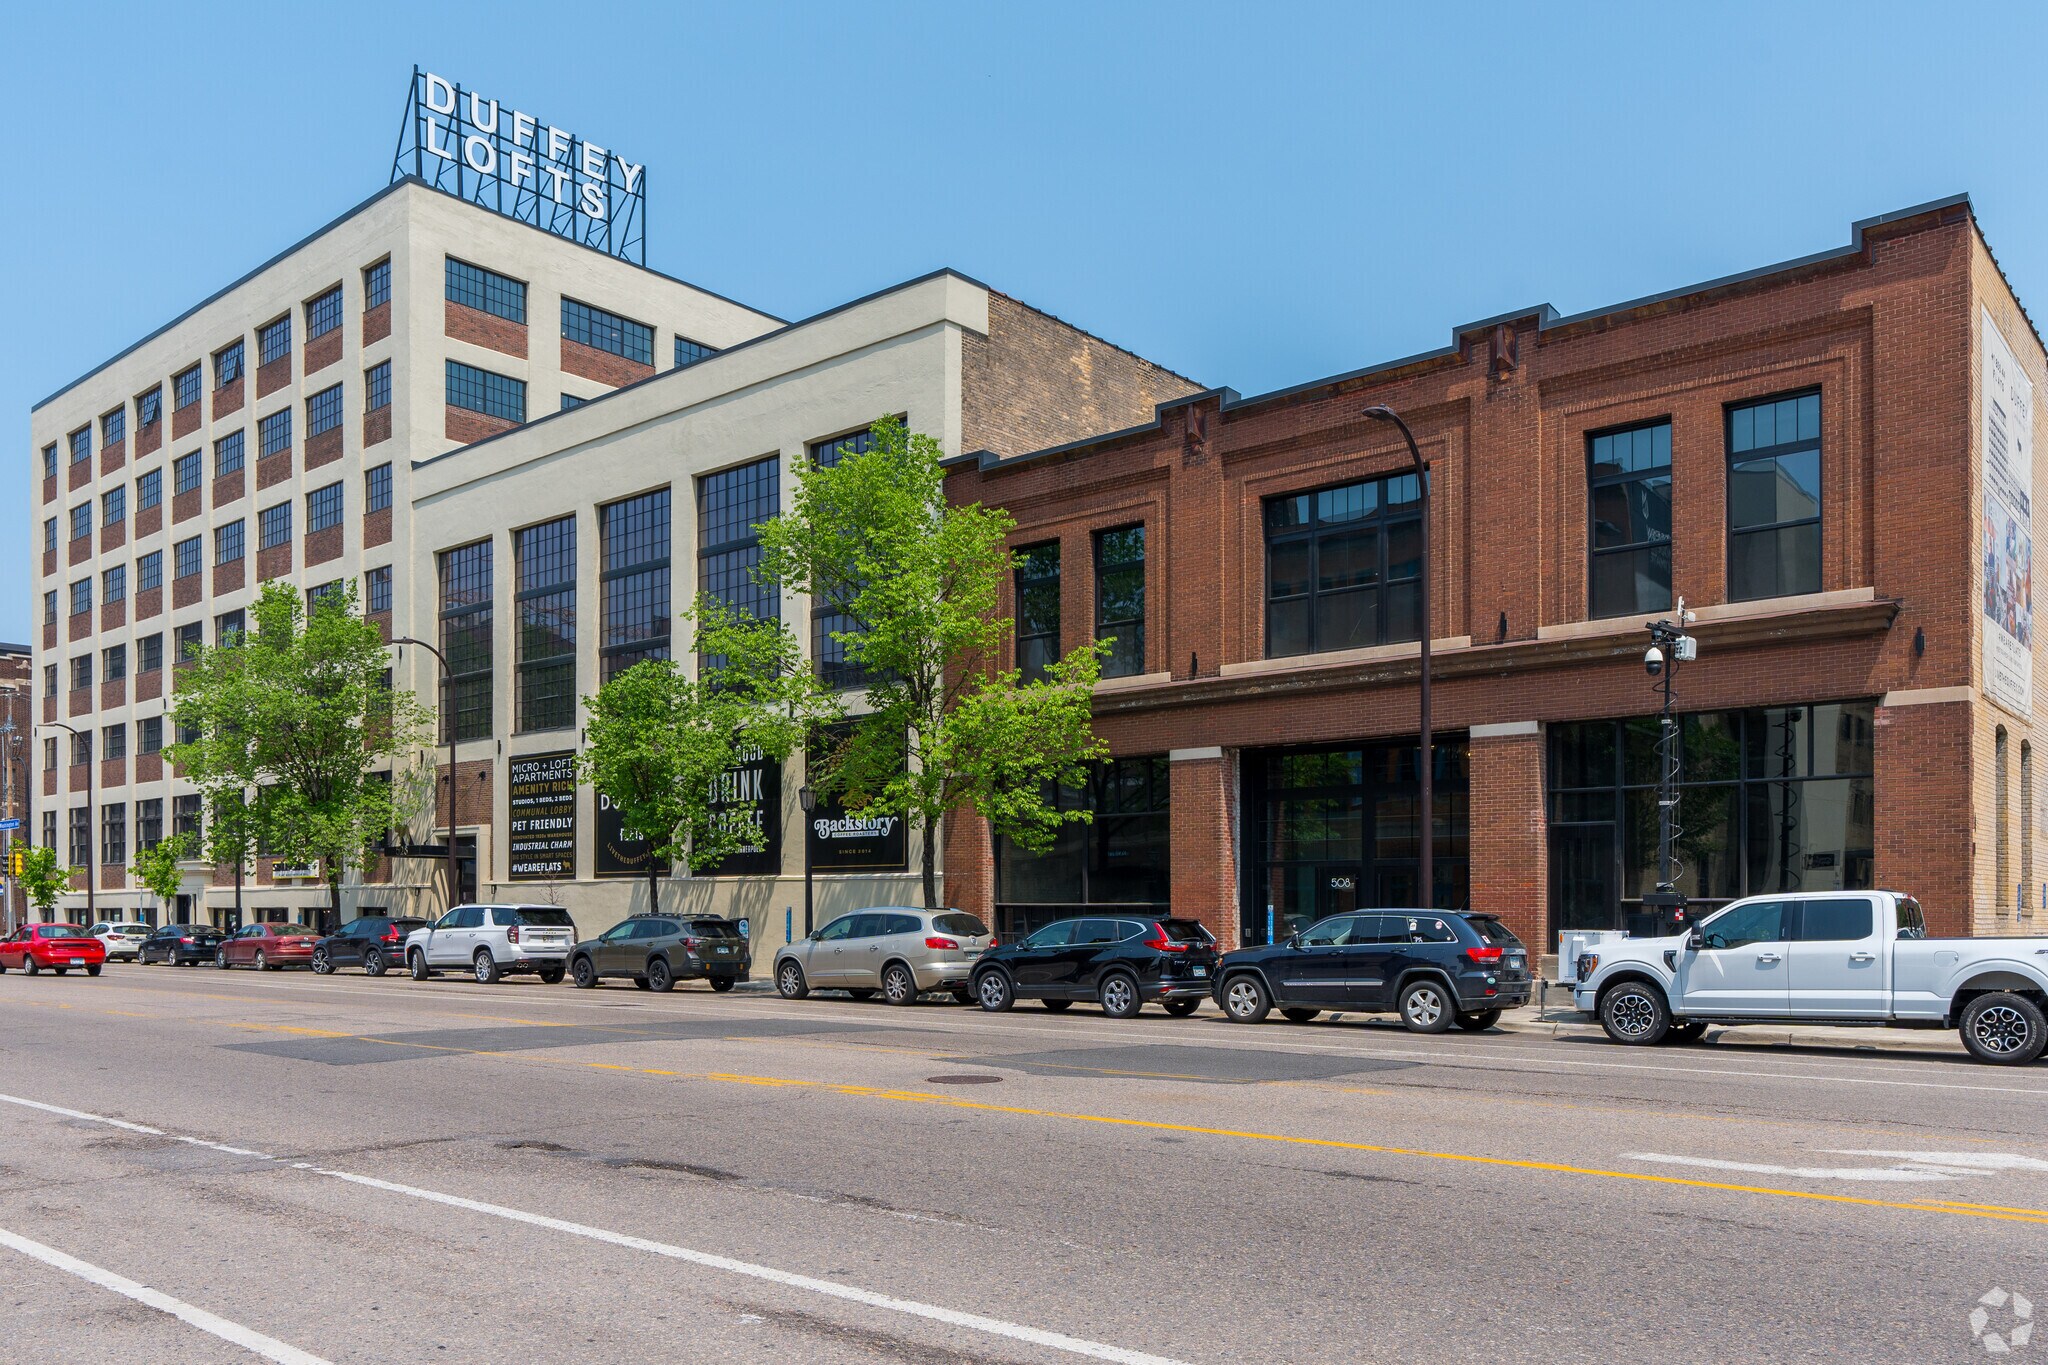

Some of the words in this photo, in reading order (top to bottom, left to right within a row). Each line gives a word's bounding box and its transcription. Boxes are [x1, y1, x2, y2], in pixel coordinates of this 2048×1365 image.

[425, 72, 642, 194] DUFFEY
[426, 116, 605, 219] LOFTS
[513, 762, 540, 774] MICRO
[542, 762, 547, 770] +
[550, 758, 572, 770] LOFT
[513, 769, 573, 783] APARTMENTS
[513, 783, 550, 796] AMENITY
[552, 780, 573, 792] RICH
[513, 798, 535, 806] STUDIOS,
[513, 807, 549, 818] COMMUNAL
[550, 805, 573, 815] LOBBY
[513, 821, 527, 831] PET
[530, 817, 573, 830] FRIENDLY
[813, 814, 898, 839] Backstory
[513, 842, 549, 851] INDUSTRIAL
[550, 840, 573, 849] CHARM
[513, 862, 562, 872] #WEAREFLATS
[1330, 877, 1351, 888] 508
